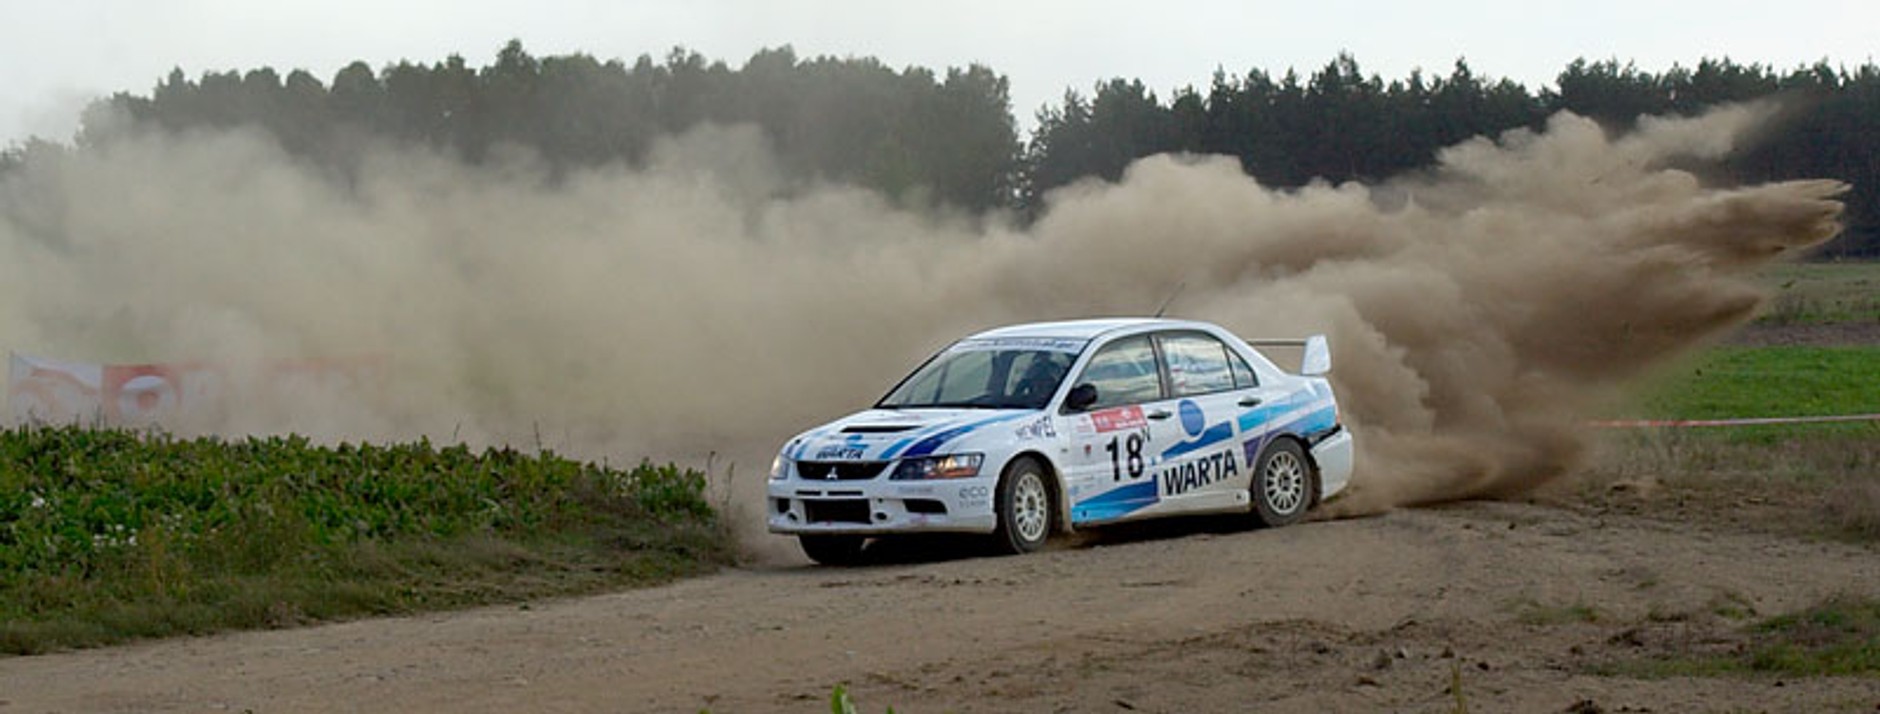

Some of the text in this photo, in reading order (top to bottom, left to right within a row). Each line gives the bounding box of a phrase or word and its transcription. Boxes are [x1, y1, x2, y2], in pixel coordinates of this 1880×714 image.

[815, 445, 864, 459] WARTA
[1105, 432, 1145, 482] 18
[1163, 448, 1238, 496] WARTA
[958, 485, 989, 499] eco
